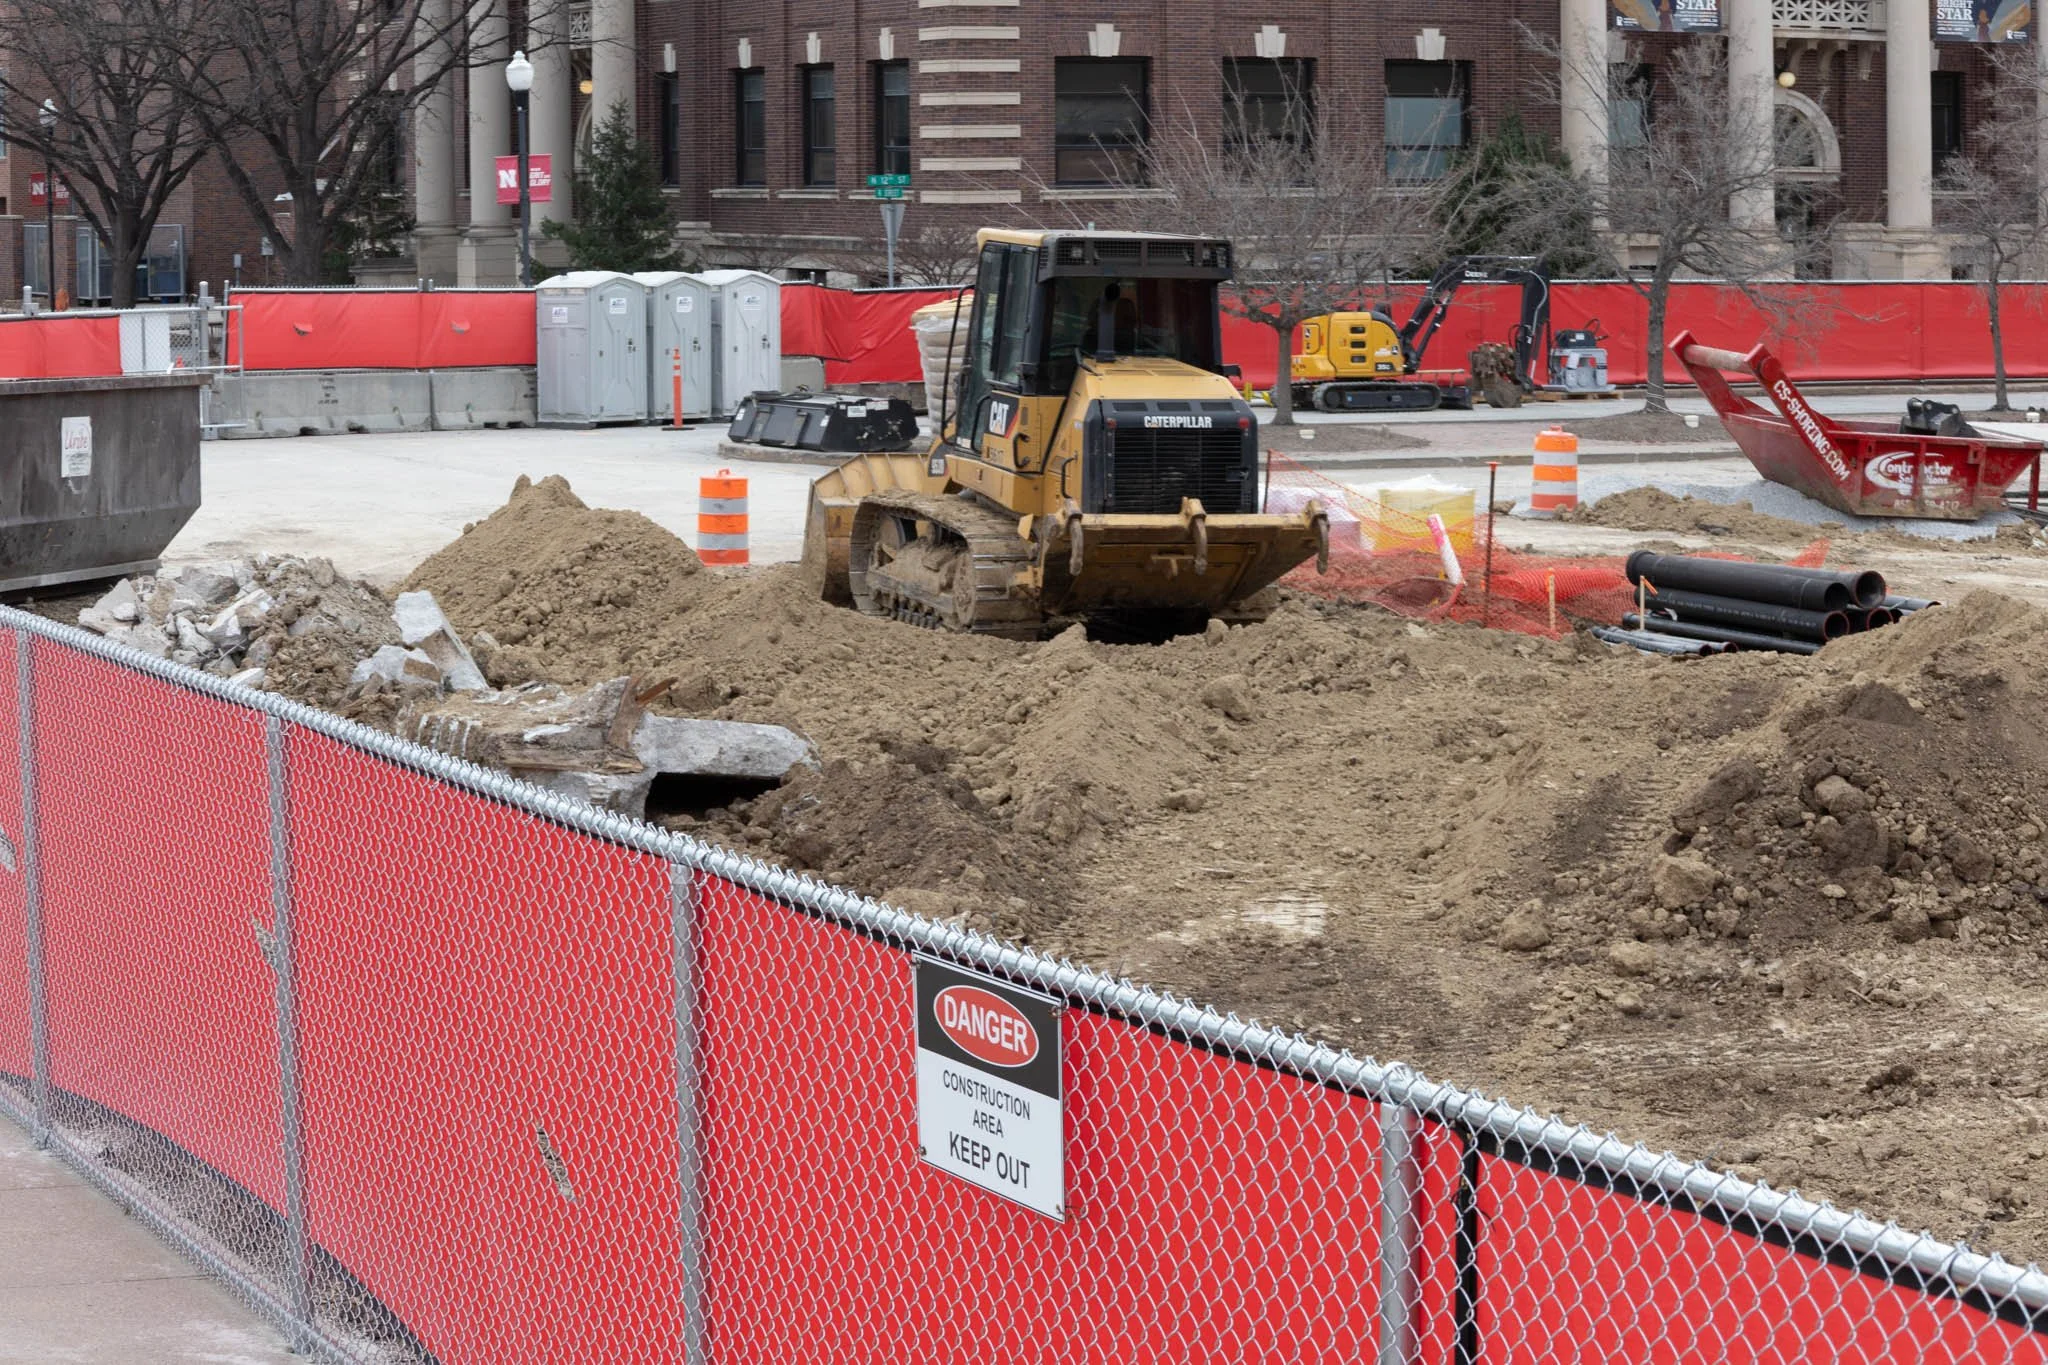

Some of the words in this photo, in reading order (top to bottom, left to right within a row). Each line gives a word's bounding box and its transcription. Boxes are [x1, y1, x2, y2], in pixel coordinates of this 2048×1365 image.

[1676, 0, 1718, 10] STAR
[1936, 8, 1973, 20] STAR
[32, 182, 44, 195] N
[499, 169, 517, 188] N
[897, 175, 907, 184] ST
[989, 401, 1010, 435] CAT
[1144, 415, 1213, 429] CATERPILLAR
[1773, 380, 1851, 480] CS-SHORING.COM
[943, 994, 1029, 1057] DANGER
[943, 1069, 1031, 1120] CONSTRUCTION
[972, 1109, 1004, 1138] AREA
[949, 1131, 991, 1170] KEEP
[996, 1151, 1031, 1189] OUT
